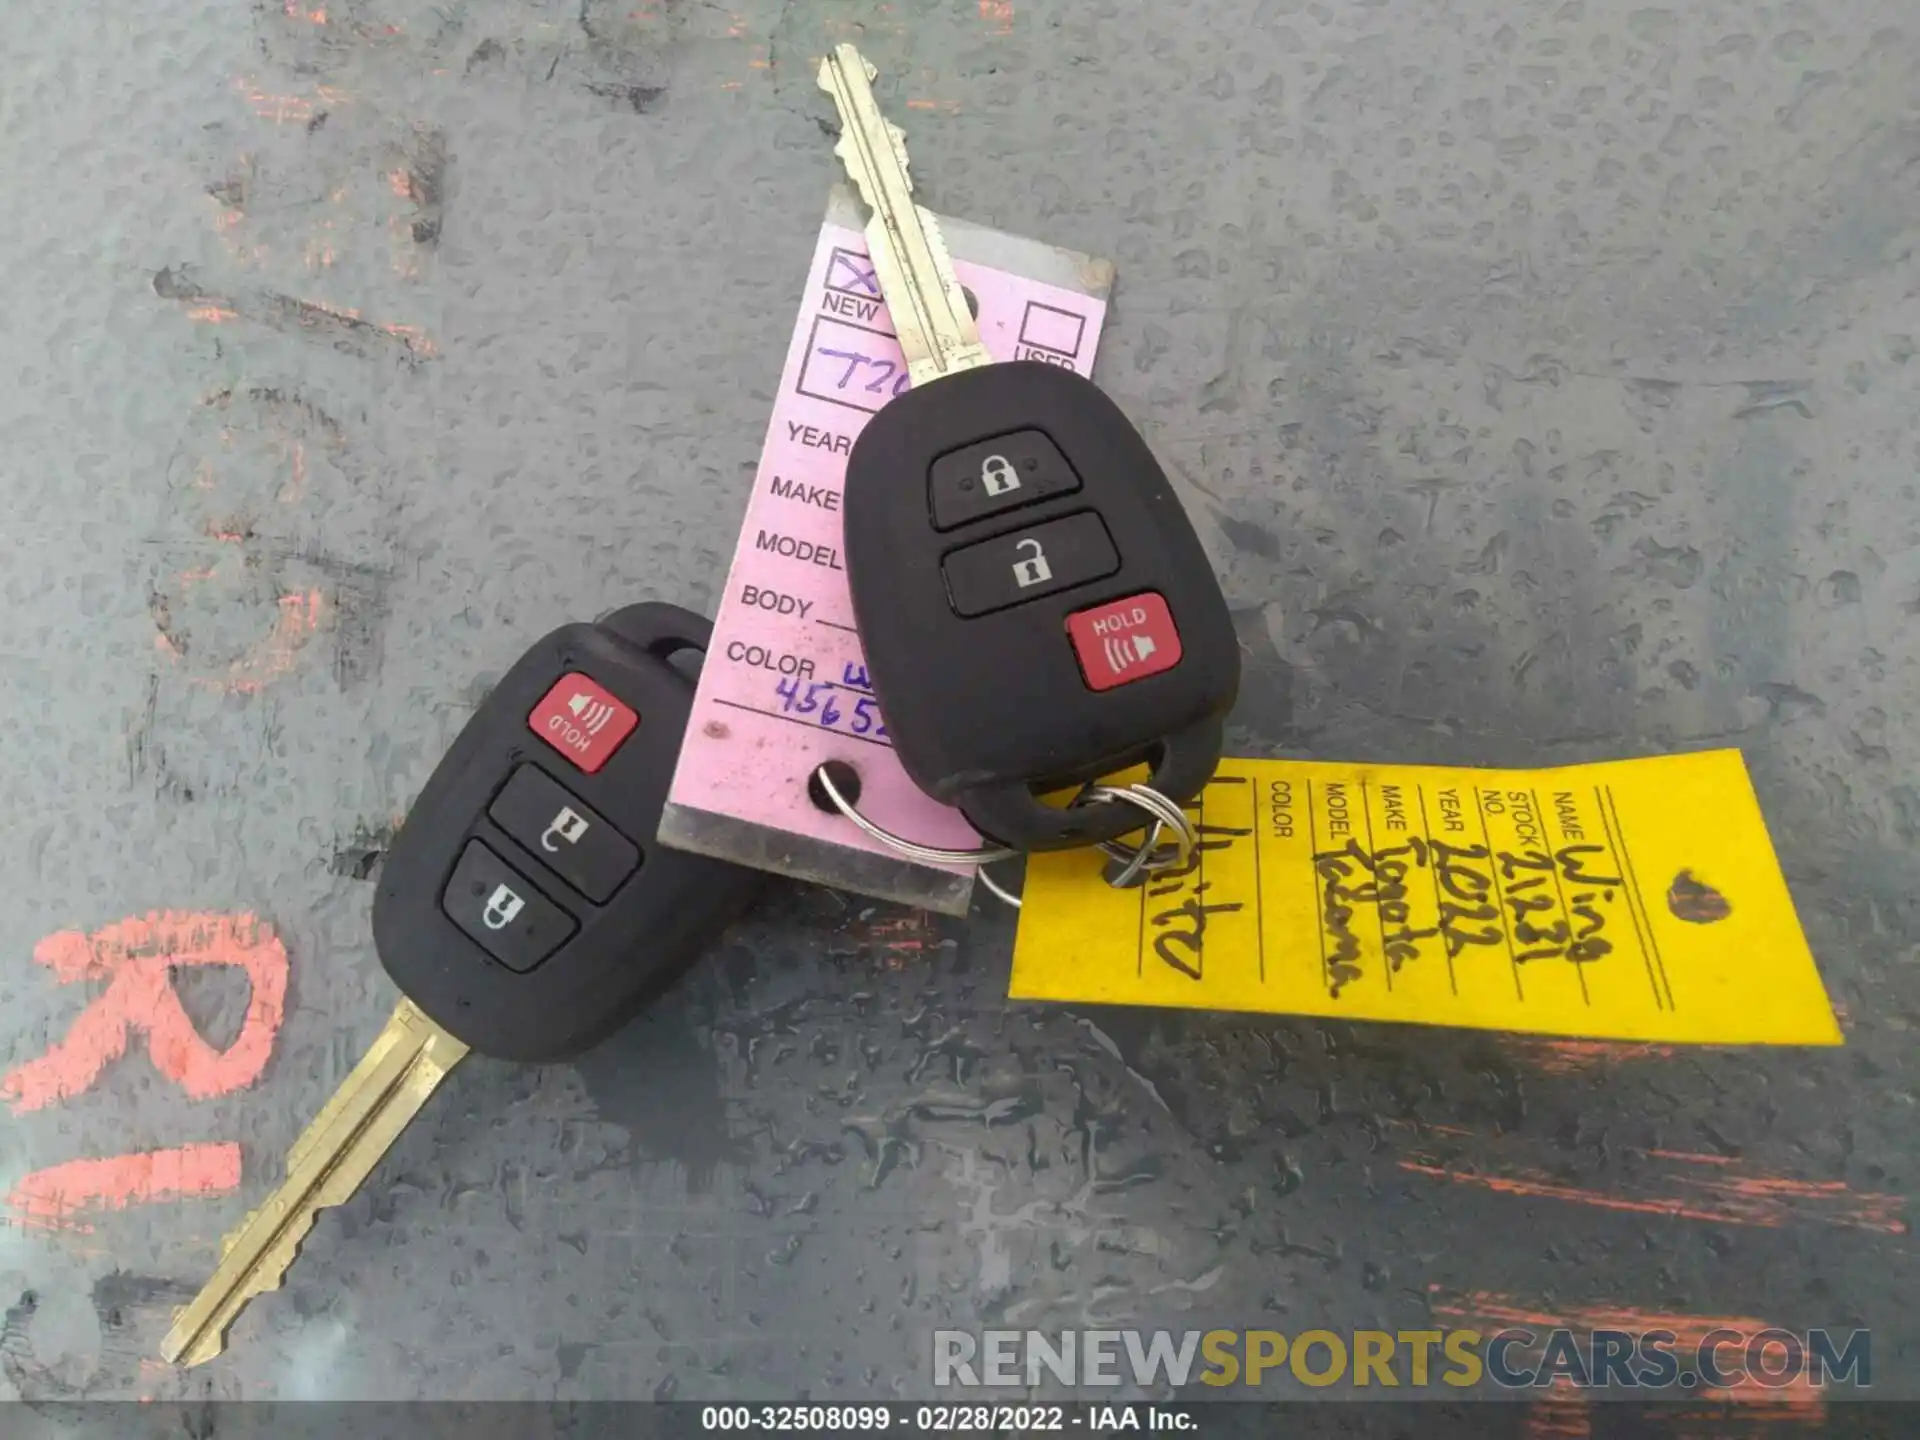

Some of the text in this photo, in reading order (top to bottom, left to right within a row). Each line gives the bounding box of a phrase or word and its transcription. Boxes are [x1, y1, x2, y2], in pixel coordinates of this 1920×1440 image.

[822, 291, 879, 321] NEW
[788, 420, 852, 456] YEAR
[770, 475, 842, 512] MAKE
[756, 529, 843, 571] MODEL
[740, 584, 814, 619] BODY
[1092, 607, 1147, 637] HOLD
[727, 641, 816, 680] COLOR
[776, 677, 887, 736] 4565
[548, 714, 592, 753] HOLD
[1271, 780, 1294, 839] COLOR
[1326, 782, 1350, 841] MODEL
[1380, 784, 1407, 832] MAKE
[1437, 788, 1465, 832] YEAR
[1482, 789, 1506, 818] NO.
[1507, 791, 1541, 848] STOCK
[1553, 791, 1585, 841] NAME
[1428, 839, 1504, 959] 2022
